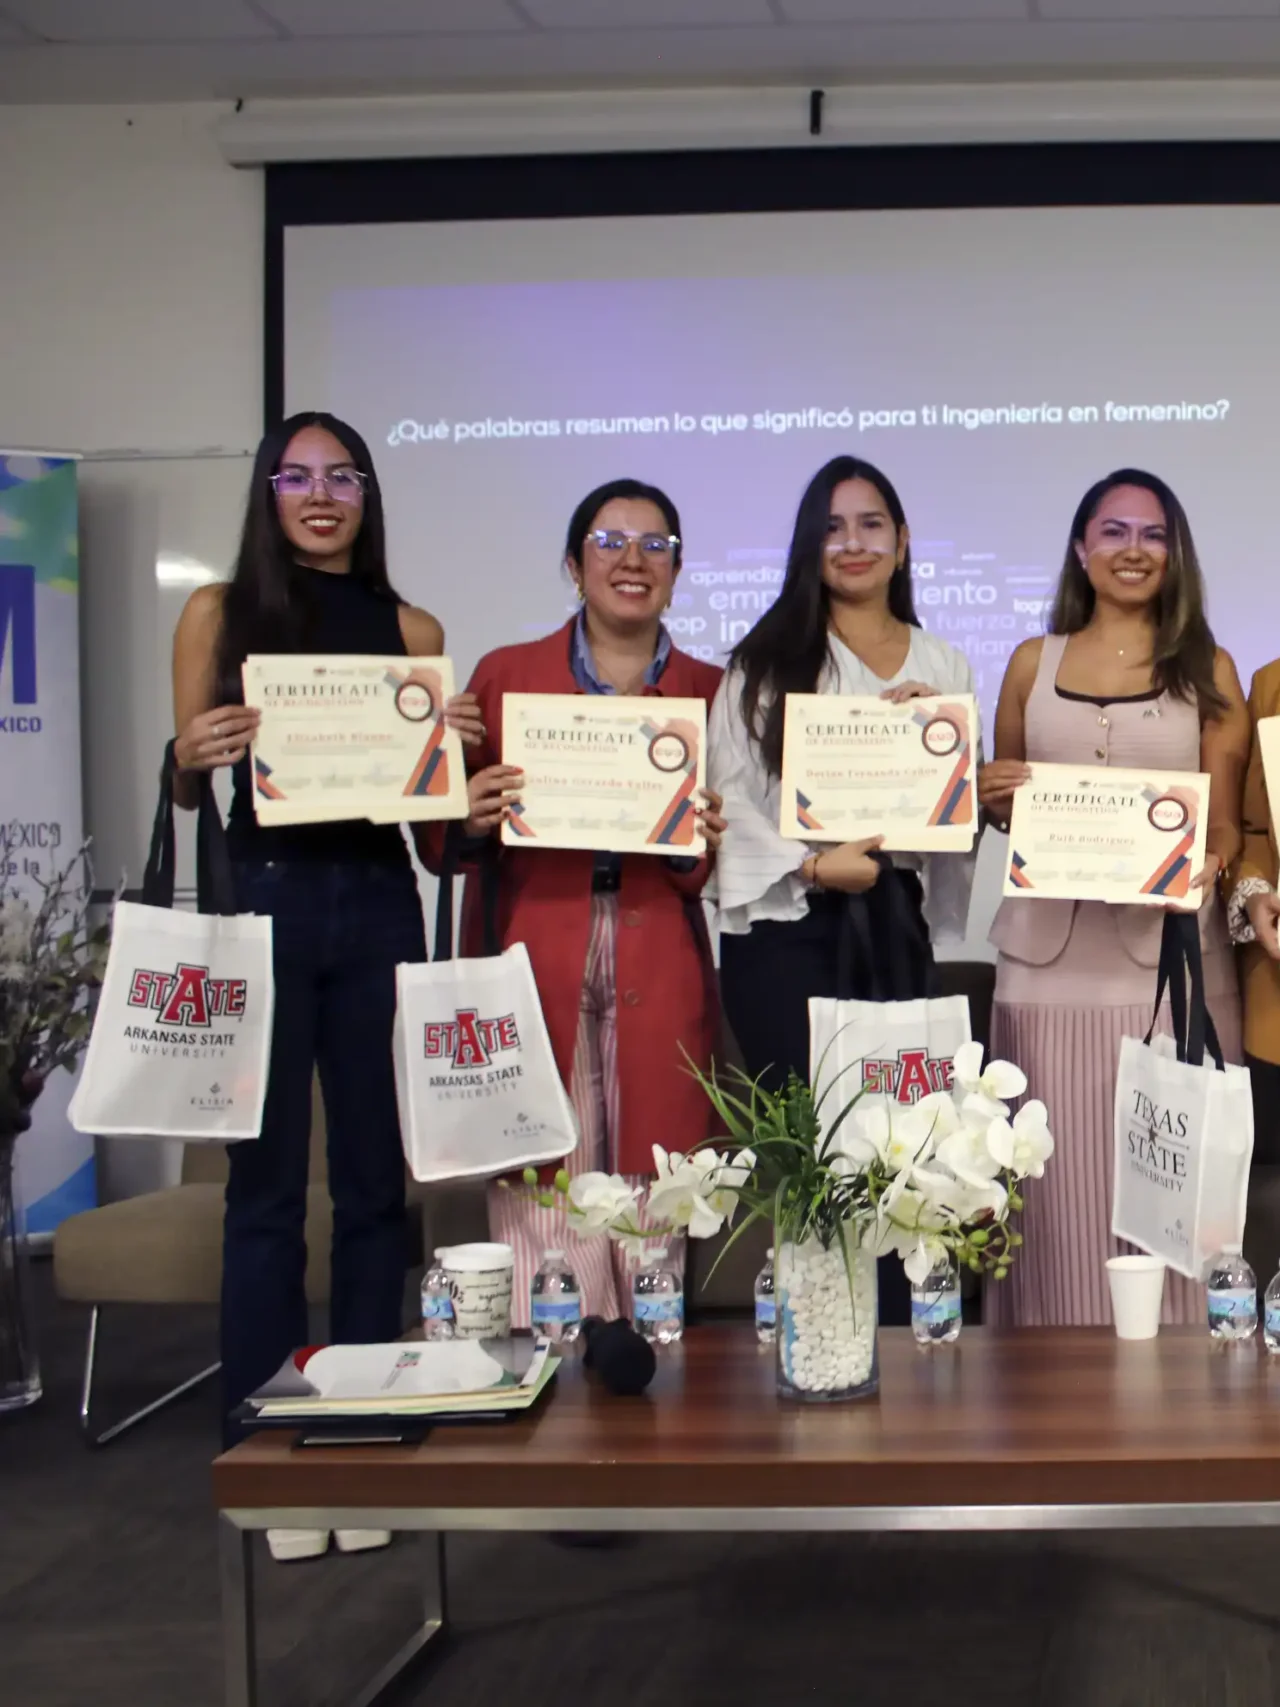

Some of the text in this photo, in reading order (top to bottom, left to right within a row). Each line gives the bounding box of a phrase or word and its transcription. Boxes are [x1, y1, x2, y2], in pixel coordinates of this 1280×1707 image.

[387, 398, 1230, 446] ¿Qué palabras resumen lo que significó para ti Ingeniería en femenino?
[690, 567, 784, 587] aprendiz
[525, 728, 637, 746] CERTIFICATE
[805, 723, 911, 736] CERTIFICATE
[1032, 792, 1138, 807] CERTIFICATE
[127, 963, 247, 1028] STATE
[124, 1026, 235, 1046] ARKANSAS STATE
[424, 1008, 521, 1070] STATE
[130, 1043, 226, 1059] UNIVERSITY
[429, 1065, 524, 1088] ARKANSAS STATE
[1133, 1089, 1189, 1138] TEXAS
[1128, 1130, 1187, 1178] STATE
